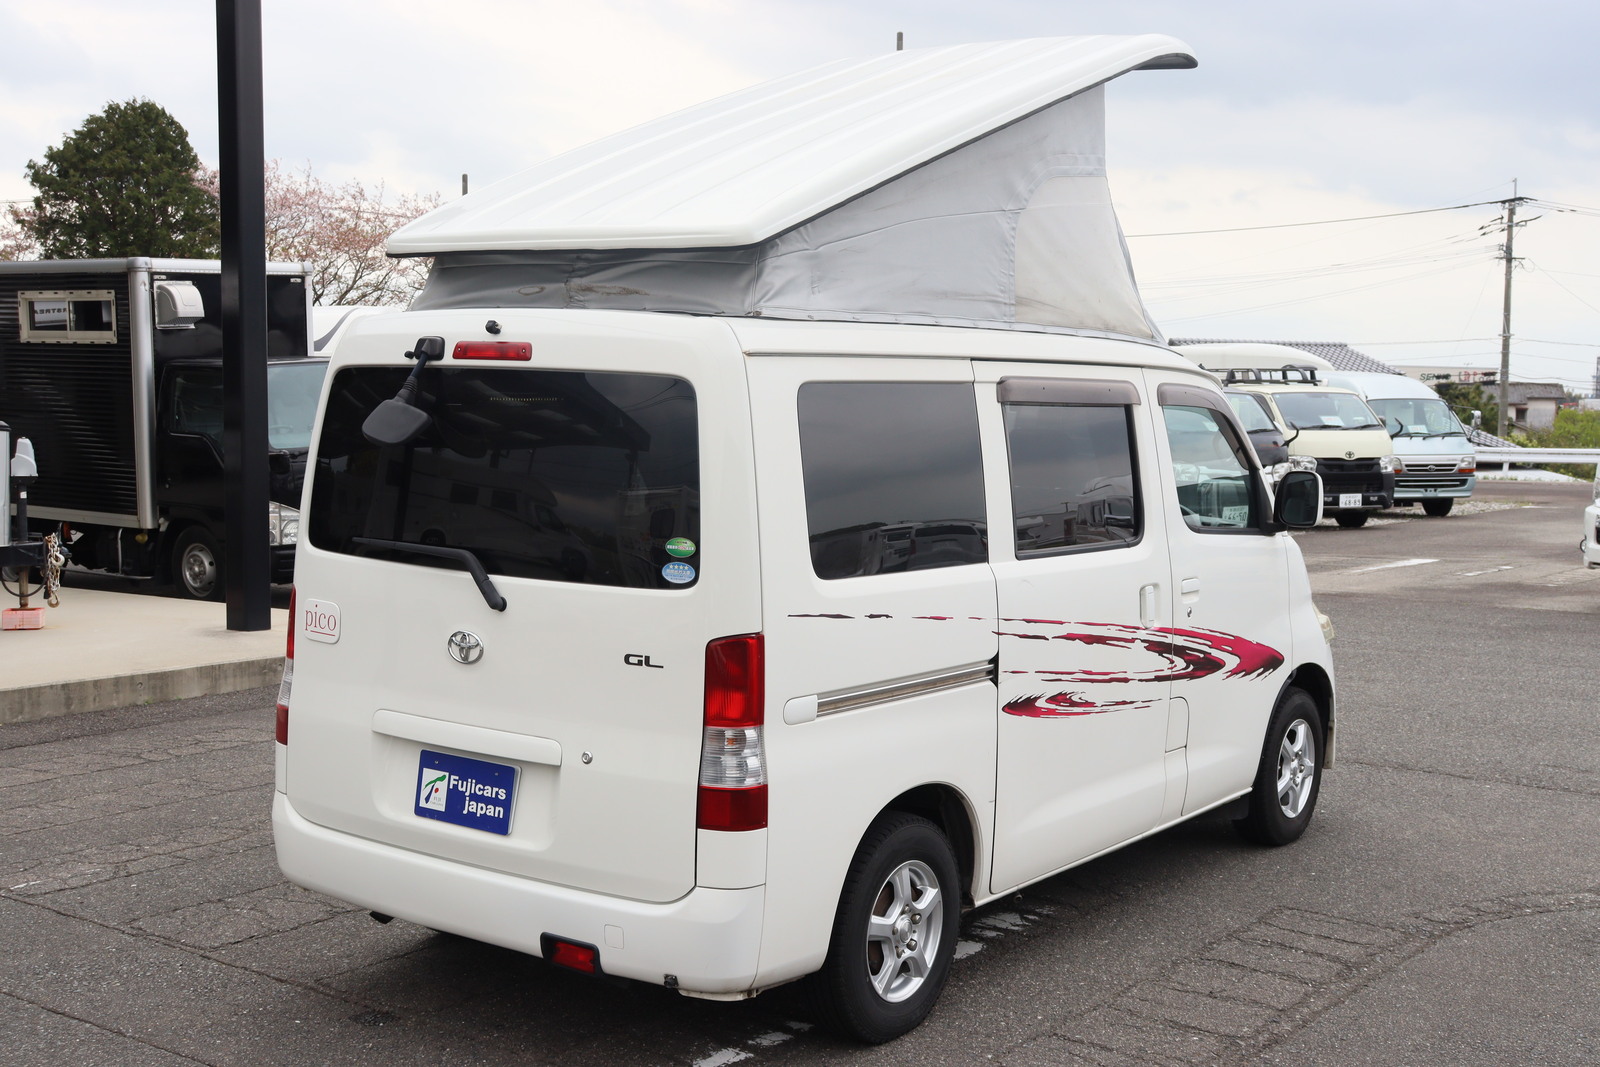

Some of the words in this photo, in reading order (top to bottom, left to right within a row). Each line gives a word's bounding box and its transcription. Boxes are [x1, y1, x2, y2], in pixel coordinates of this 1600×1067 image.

[305, 604, 337, 631] pico
[623, 653, 664, 669] GL
[449, 774, 507, 800] Fujicars
[462, 796, 504, 819] japan
